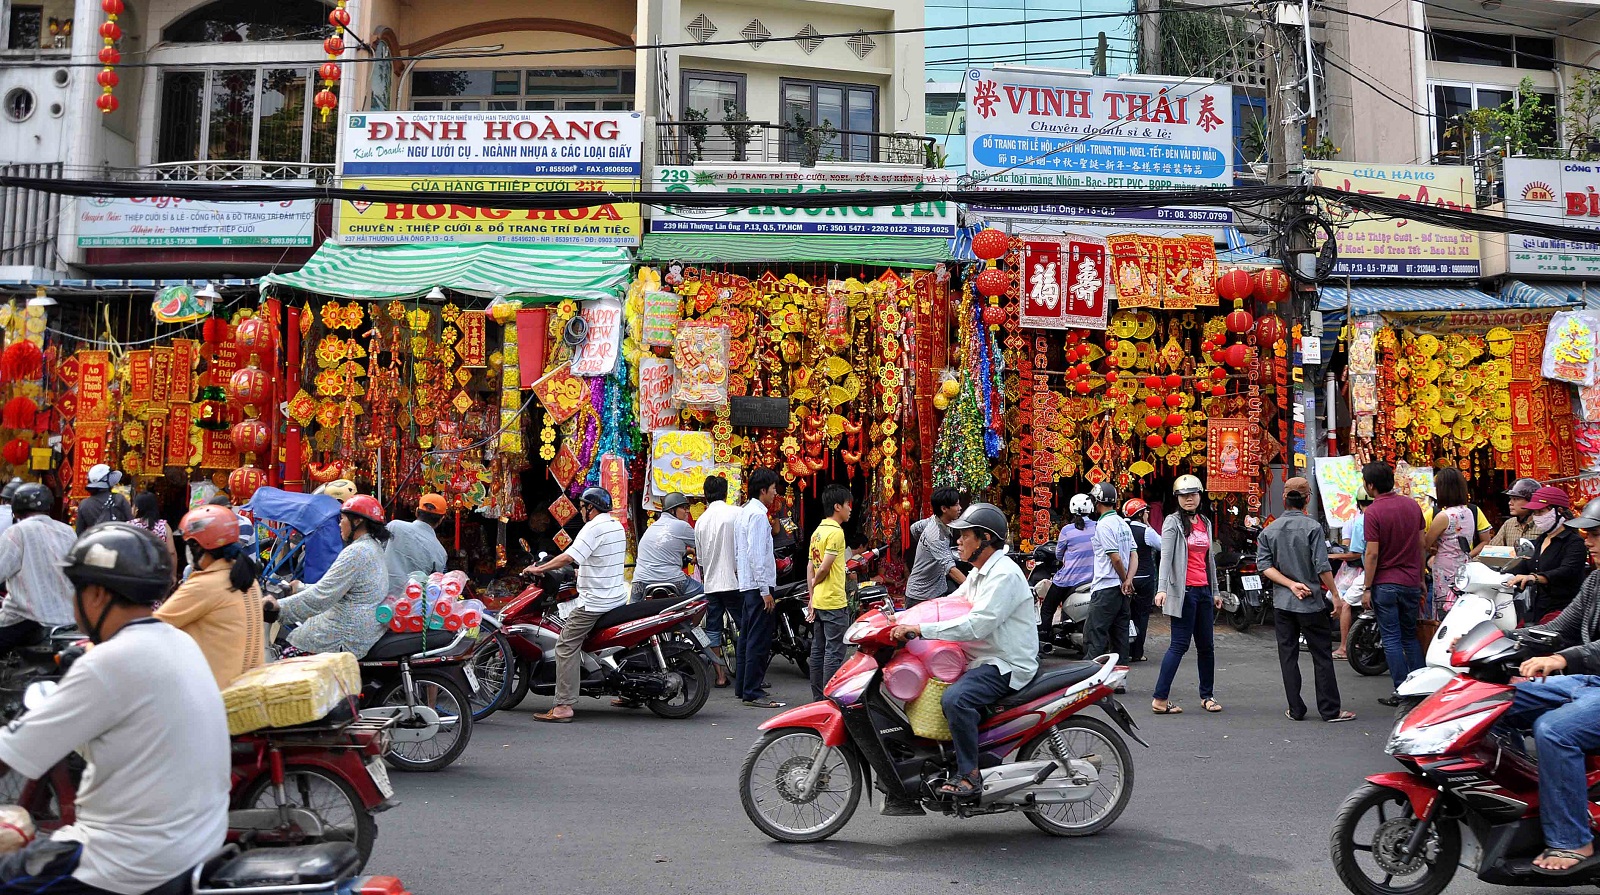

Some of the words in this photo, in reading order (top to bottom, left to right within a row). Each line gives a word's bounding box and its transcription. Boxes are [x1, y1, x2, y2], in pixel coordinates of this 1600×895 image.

[1002, 84, 1092, 118] VINH
[1102, 87, 1189, 124] THÁI
[1196, 94, 1224, 133] 泰
[367, 115, 468, 141] ĐÌNH
[483, 115, 621, 141] HOÀNG
[1030, 120, 1078, 134] Chuyên
[1142, 128, 1152, 138] &
[353, 147, 374, 160] Kinh
[483, 143, 517, 158] NGÀNH
[551, 148, 558, 158] &
[561, 143, 581, 158] CÁC
[584, 146, 606, 160] LOẠI
[994, 139, 1016, 149] TRANG
[1090, 145, 1112, 156] TRUNG
[1113, 147, 1126, 156] THU
[660, 169, 689, 182] 239
[769, 172, 783, 180] TRÍ
[1353, 168, 1387, 180] CỬA
[1391, 168, 1435, 180] HÀNG
[1564, 164, 1591, 173] CÔNG
[444, 179, 484, 191] HÀNG
[574, 180, 605, 192] 237
[1056, 175, 1080, 186] Nhôm
[1108, 178, 1123, 188] PET
[1127, 178, 1144, 190] PVC
[1158, 210, 1172, 218] ĐT:
[1174, 210, 1186, 218] 08.
[1188, 211, 1228, 220] 3857.0799
[350, 222, 394, 232] CHUYÊN
[406, 223, 440, 235] THIỆP
[551, 224, 569, 233] TRÍ
[573, 224, 599, 233] ĐÁM
[604, 225, 630, 235] TIỆC
[1435, 234, 1458, 244] Trang
[1380, 264, 1398, 273] TP.HCM
[1030, 262, 1060, 310] 福
[581, 308, 619, 324] HAPPY
[580, 342, 613, 358] YEAR
[643, 365, 668, 380] 2012
